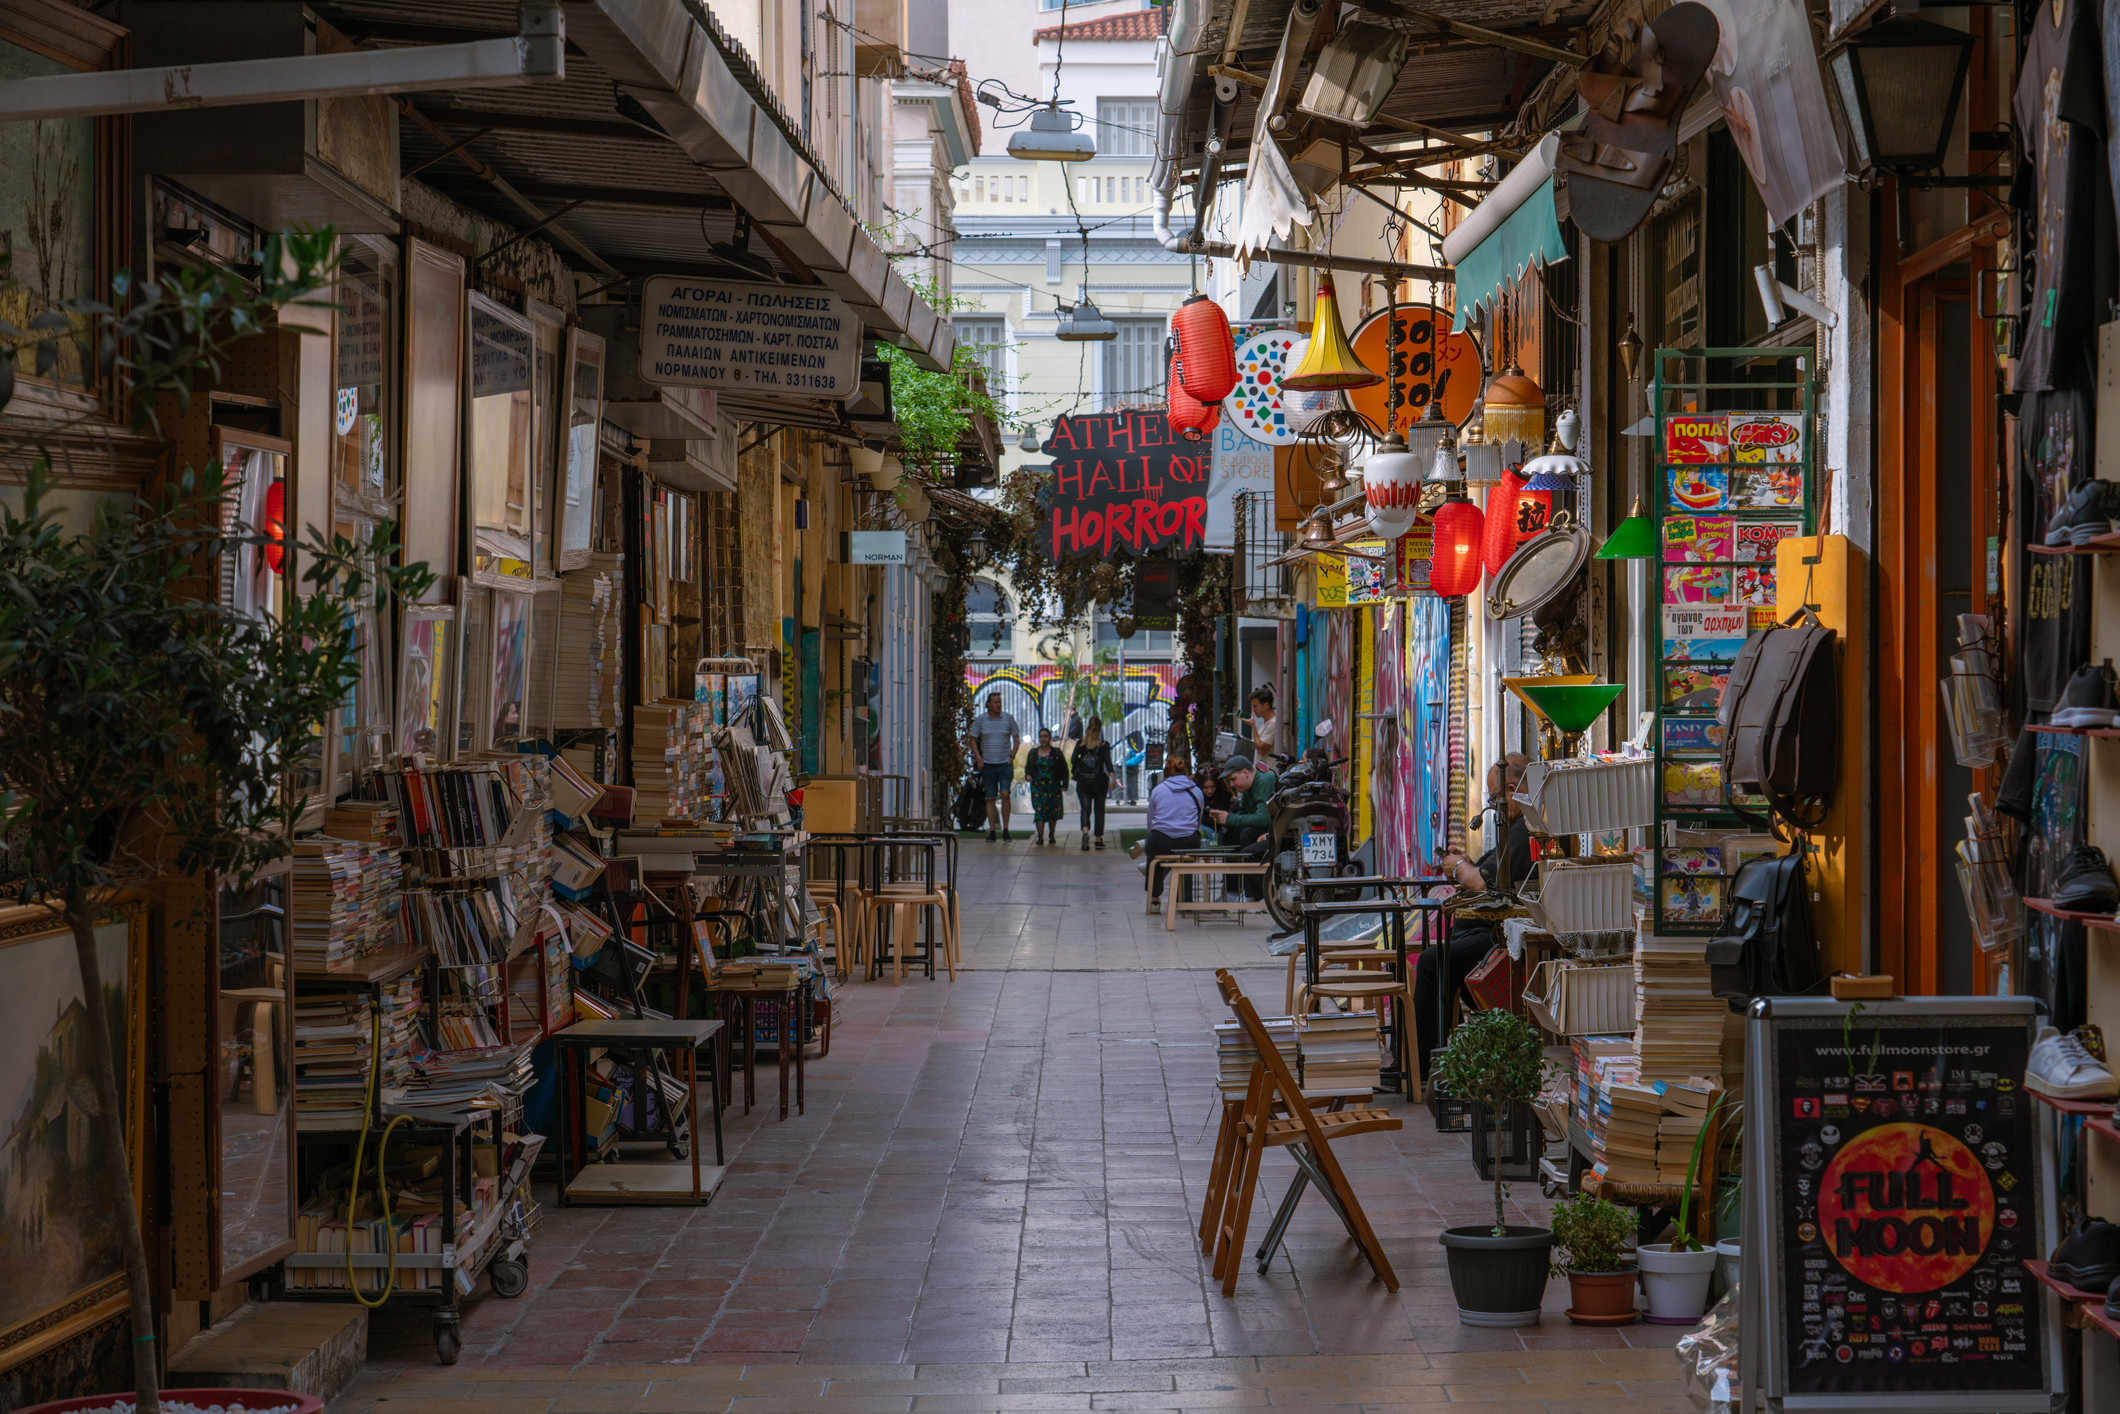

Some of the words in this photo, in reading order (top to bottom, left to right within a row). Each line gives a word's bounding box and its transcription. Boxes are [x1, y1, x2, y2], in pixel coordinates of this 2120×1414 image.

[671, 287, 732, 304] ΑΓΟΡΑΙ
[748, 293, 831, 311] ΠΩΛΗΣΕΙΣ
[658, 304, 727, 322] ΝΟΜΙΣΜΑΤΩΝ
[735, 310, 840, 332] ΧΑΡΤΟΝΟΜΙΣΜΑΤΩΝ
[657, 323, 754, 343] ΓΡΑΜΜΑΤΟΣΗΜΩΝ
[763, 332, 794, 347] ΚΑΡΤ.
[797, 334, 839, 350] ΠΟΣΤΑΛ
[667, 344, 721, 360] ΠΑΛΑΙΩΝ
[730, 350, 825, 369] ΑΝΤΙΚΕΙΜΕΝΩΝ
[655, 362, 726, 379] ΝΟΡΜΑΝΟΥ
[754, 370, 781, 384] ΤΗΛ.
[786, 373, 835, 389] 3311638
[1221, 456, 1271, 465] BOUTIQUE
[1221, 464, 1271, 479] STORE
[1055, 456, 1163, 501] HALL
[1050, 496, 1207, 561] HORROR
[1739, 527, 1796, 541] ΚΟΜΙΞ
[1677, 625, 1693, 635] των
[1312, 836, 1333, 847] XMY
[1312, 850, 1334, 860] 734
[1815, 1044, 1991, 1056] www.fullmoonstore.gr
[1835, 1171, 1970, 1212] FULL
[1835, 1216, 1981, 1258] MOON
